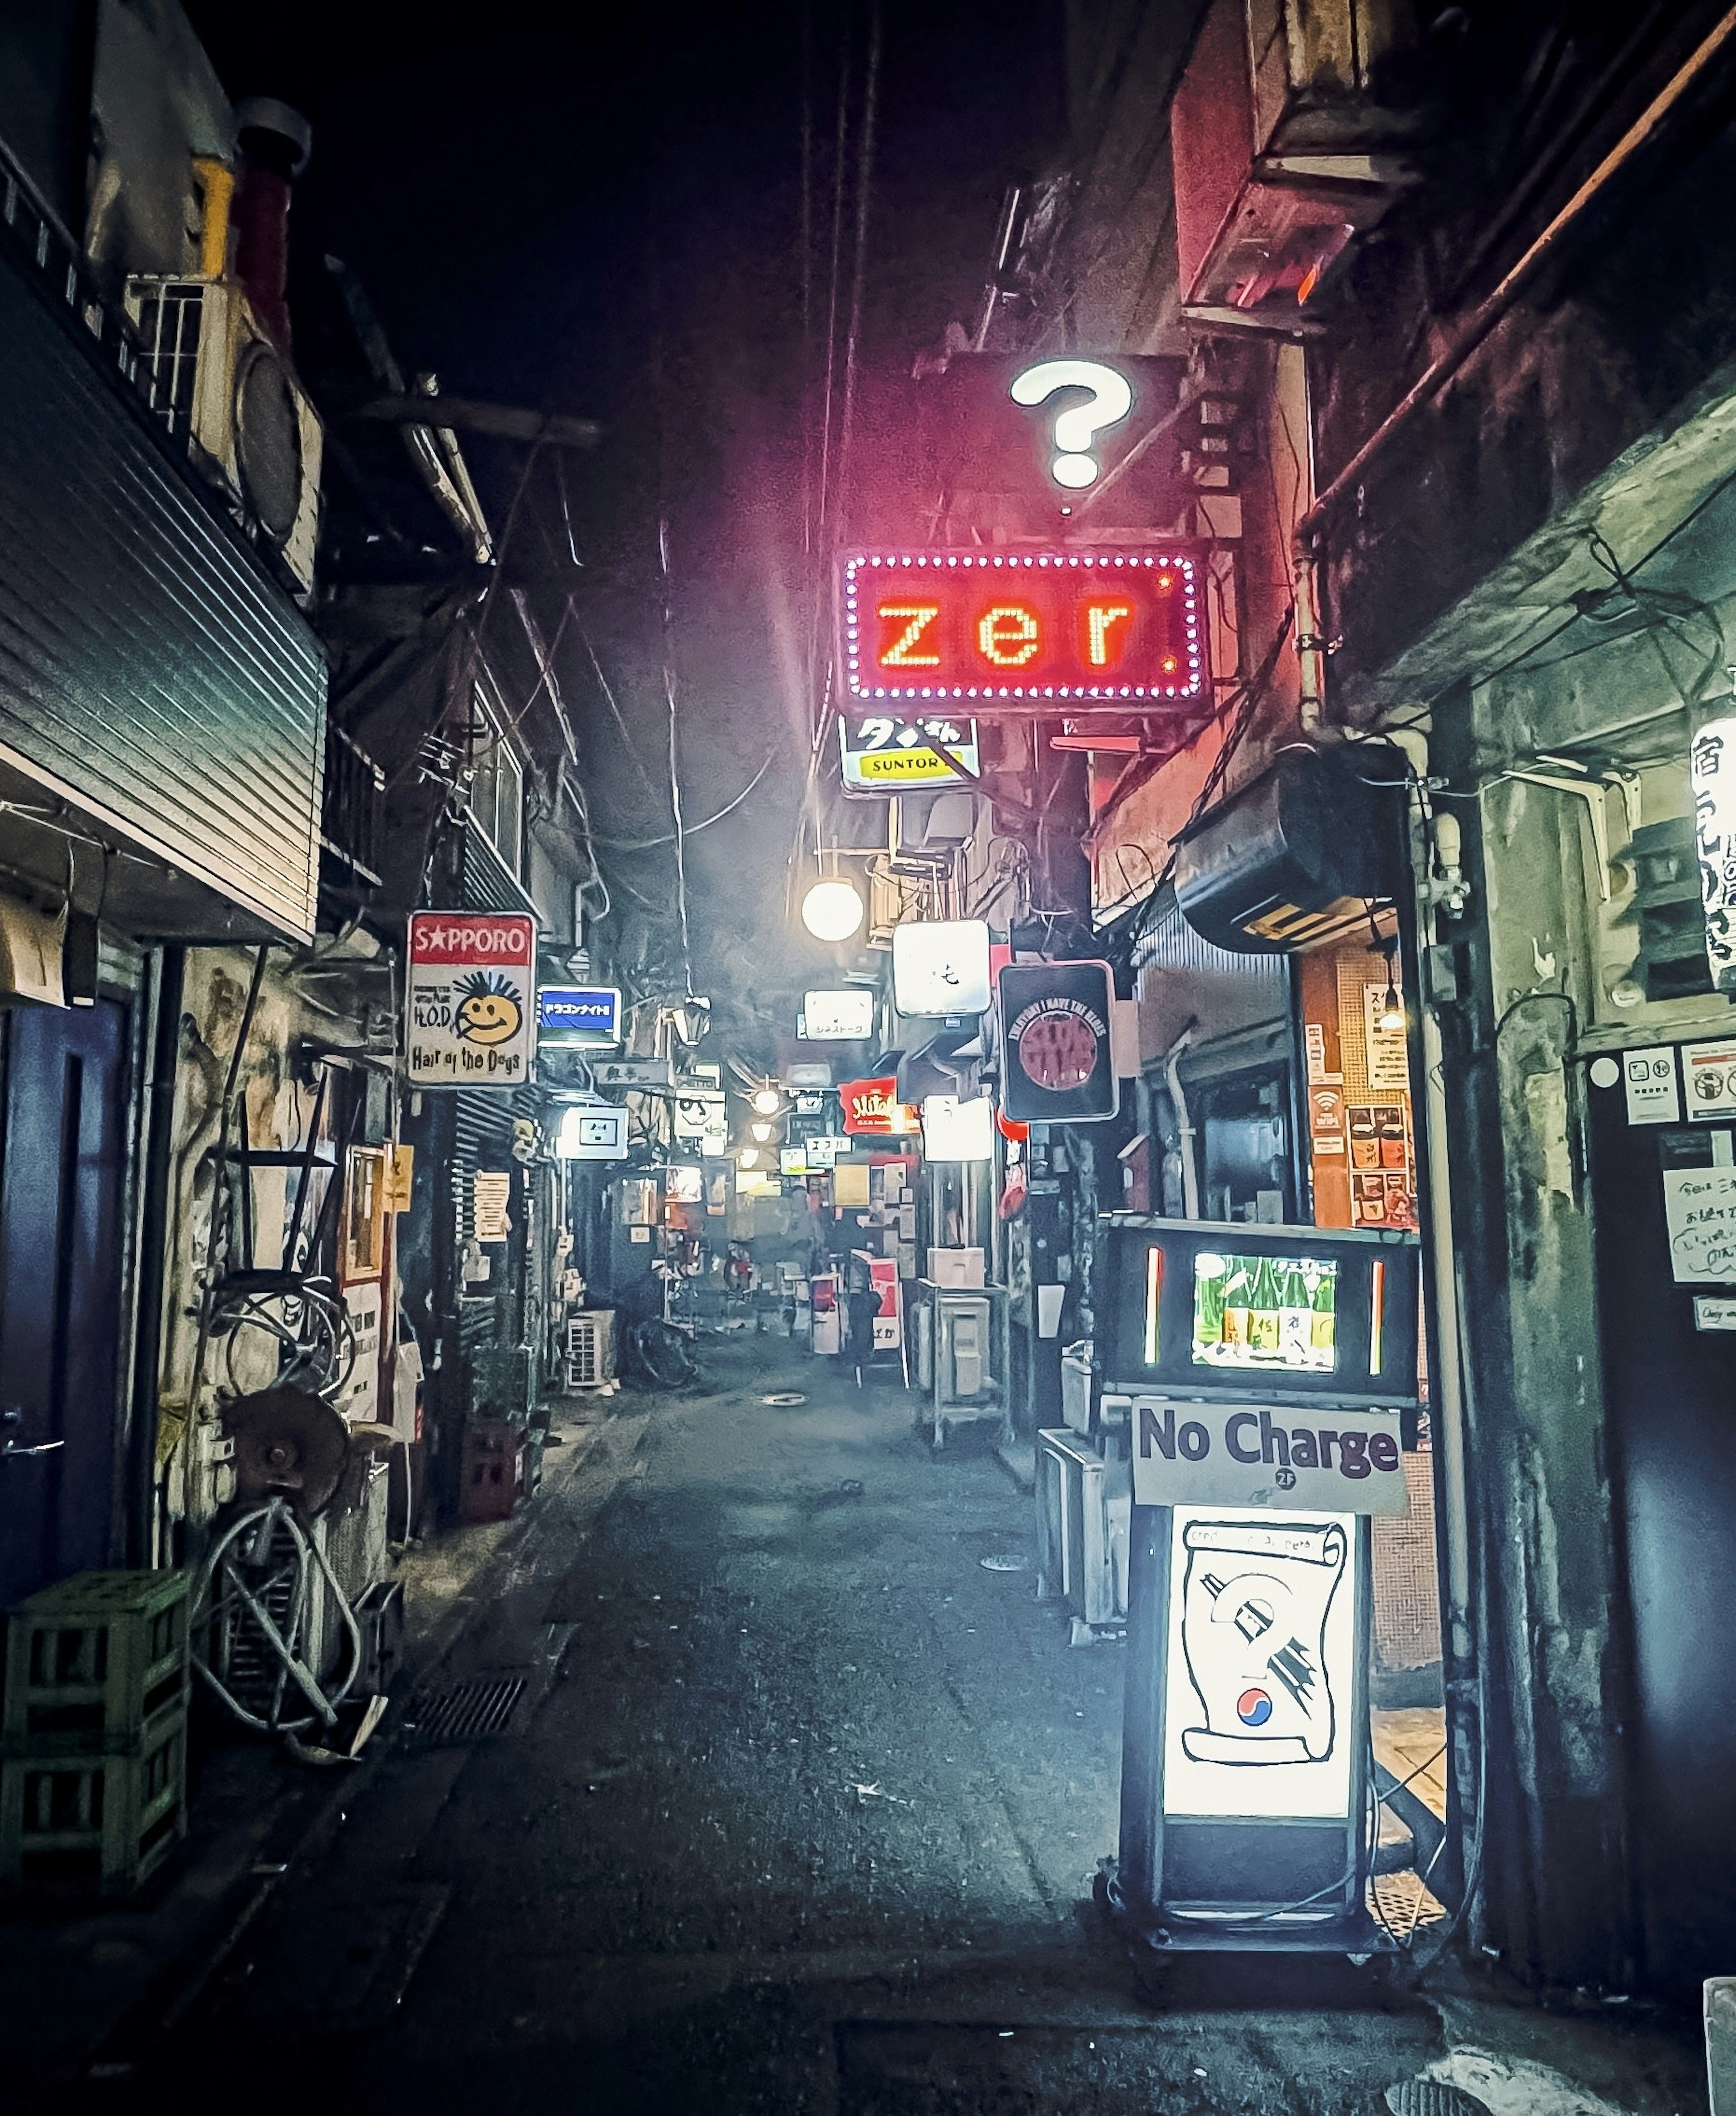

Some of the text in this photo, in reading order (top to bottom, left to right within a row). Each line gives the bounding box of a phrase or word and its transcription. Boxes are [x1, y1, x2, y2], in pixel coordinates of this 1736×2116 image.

[873, 758, 948, 771] SUNTOR
[413, 1045, 441, 1070] Hair
[462, 1046, 484, 1070] the
[1139, 1408, 1400, 1479] No Charge
[1277, 1473, 1294, 1486] 2F
